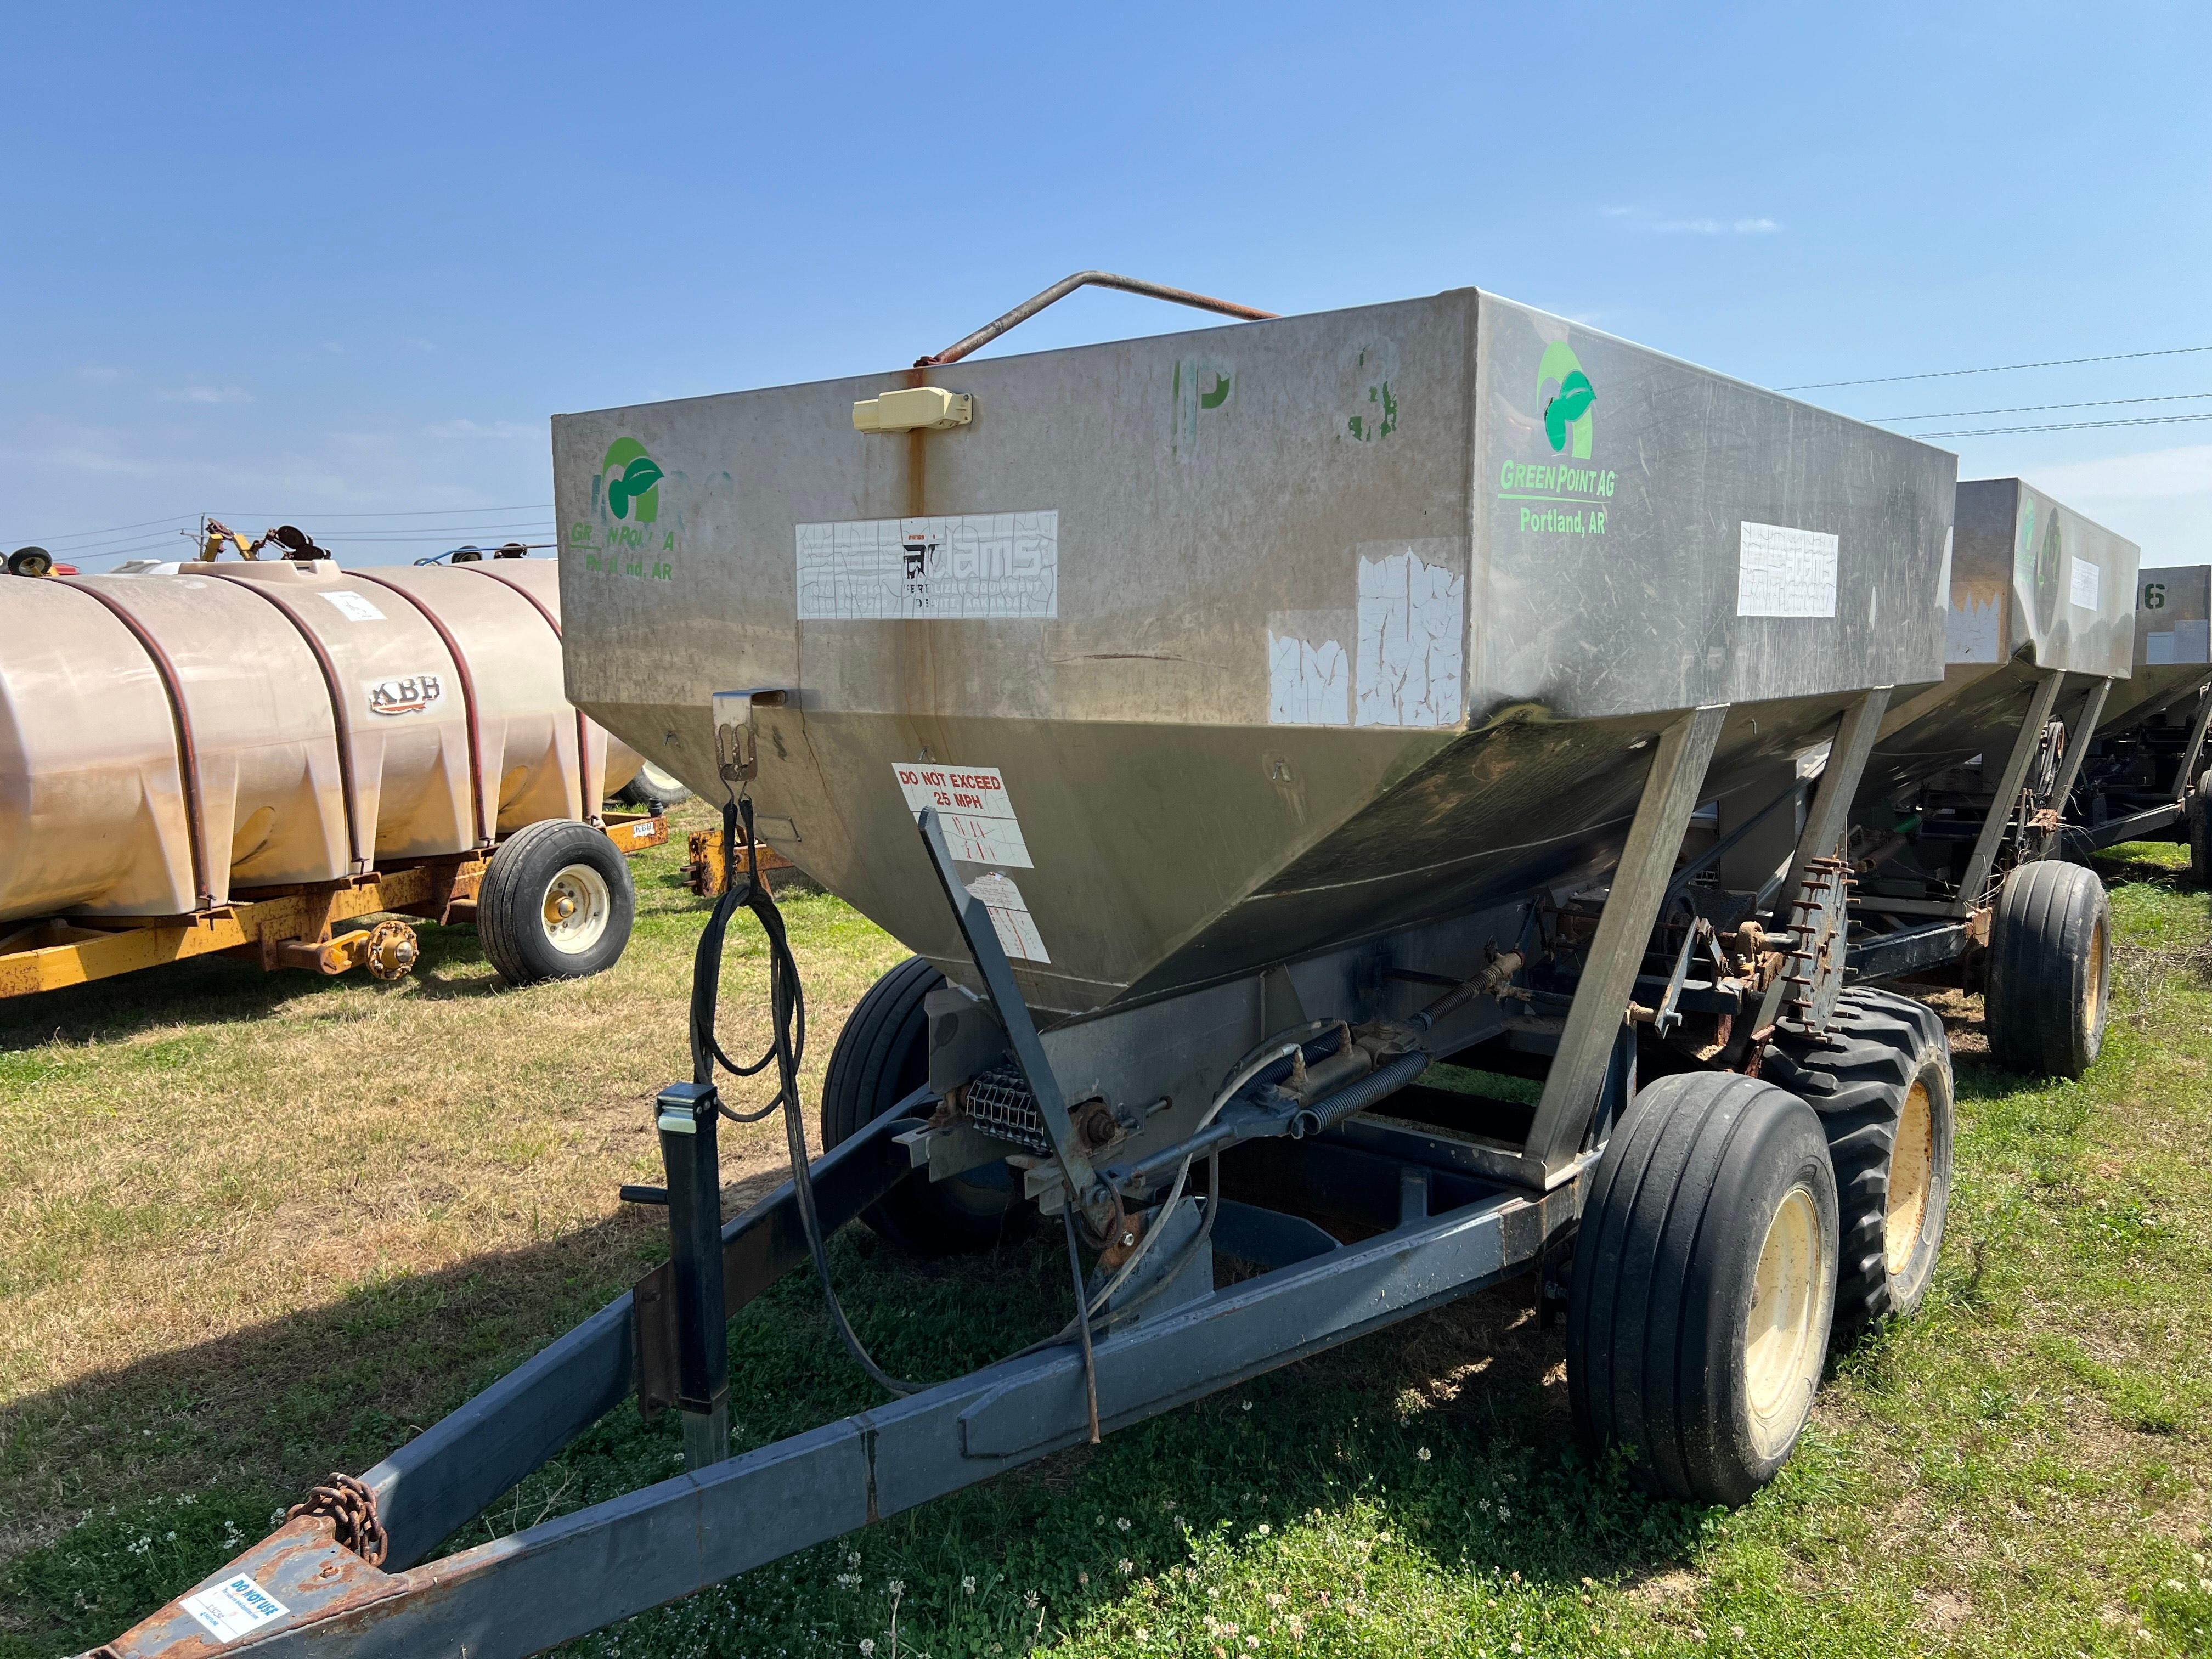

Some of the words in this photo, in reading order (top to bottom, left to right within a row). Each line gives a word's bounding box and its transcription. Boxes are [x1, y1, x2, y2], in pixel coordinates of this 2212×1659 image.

[1596, 470, 1615, 496] AG
[1520, 507, 1585, 538] Portland,
[1589, 511, 1605, 534] AR
[652, 562, 673, 580] AR
[899, 771, 918, 785] DO
[921, 772, 947, 787] NOT
[950, 774, 1001, 791] EXCEED
[934, 792, 951, 806] 25
[953, 793, 983, 809] MPH
[230, 1579, 249, 1592] DO
[242, 1589, 266, 1605] NOT
[257, 1601, 279, 1616] USE
